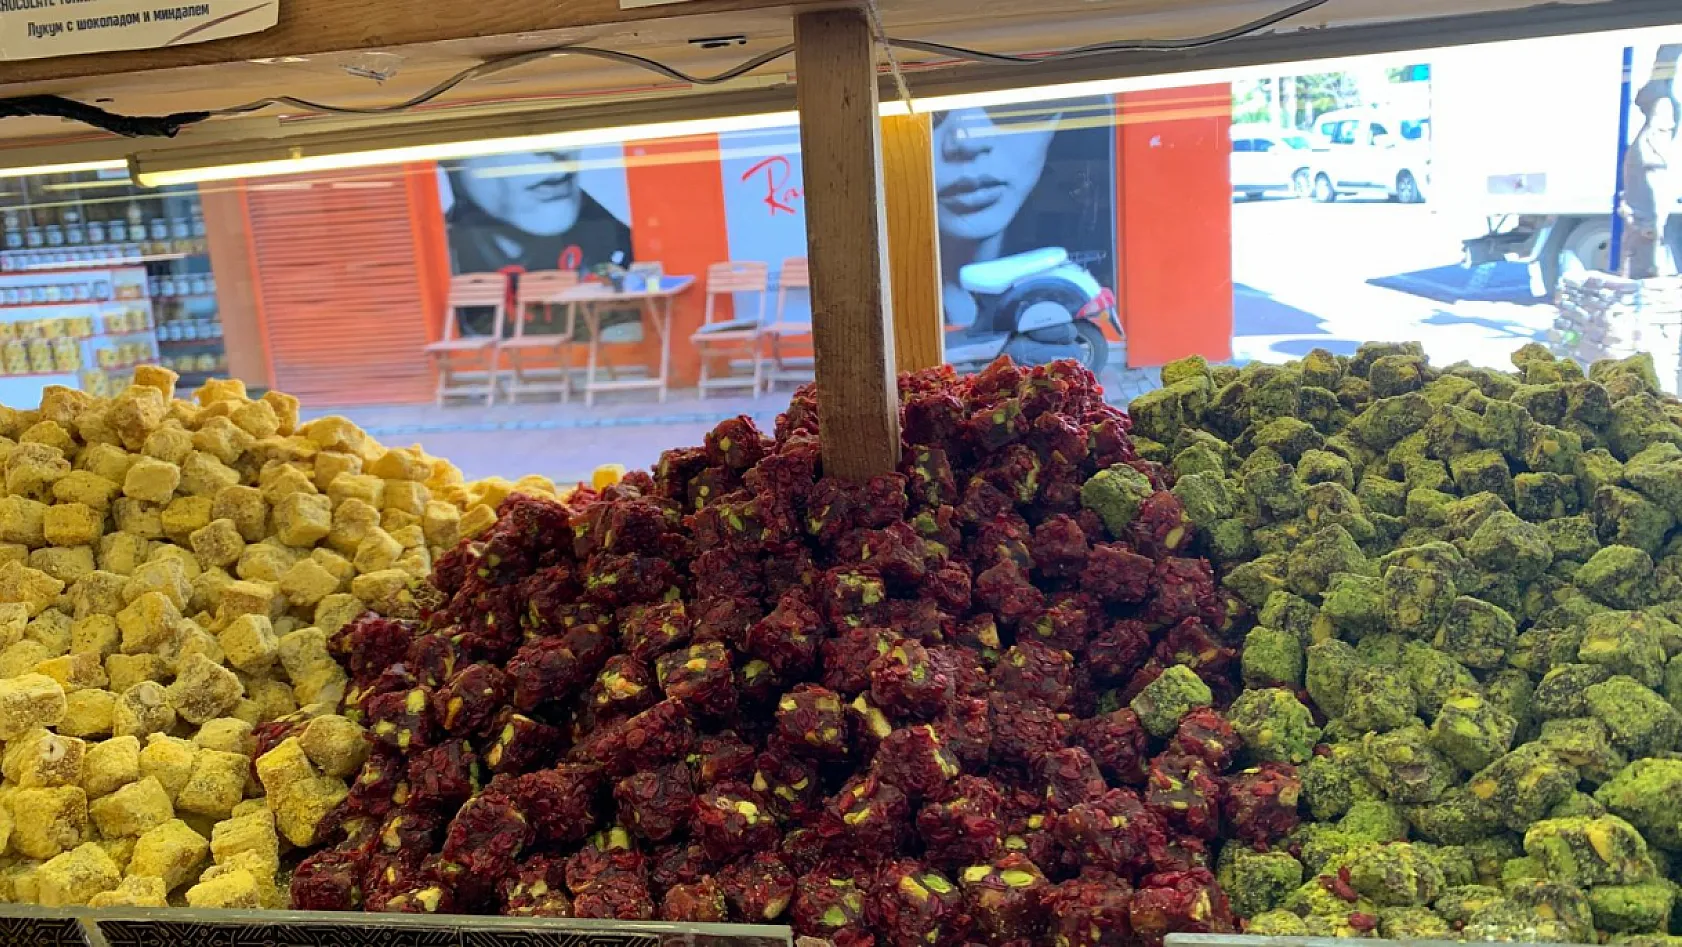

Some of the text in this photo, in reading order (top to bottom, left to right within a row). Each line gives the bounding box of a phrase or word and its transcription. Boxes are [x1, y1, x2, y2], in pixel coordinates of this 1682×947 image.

[28, 3, 209, 38] Лукум с шоколадом и миндалем
